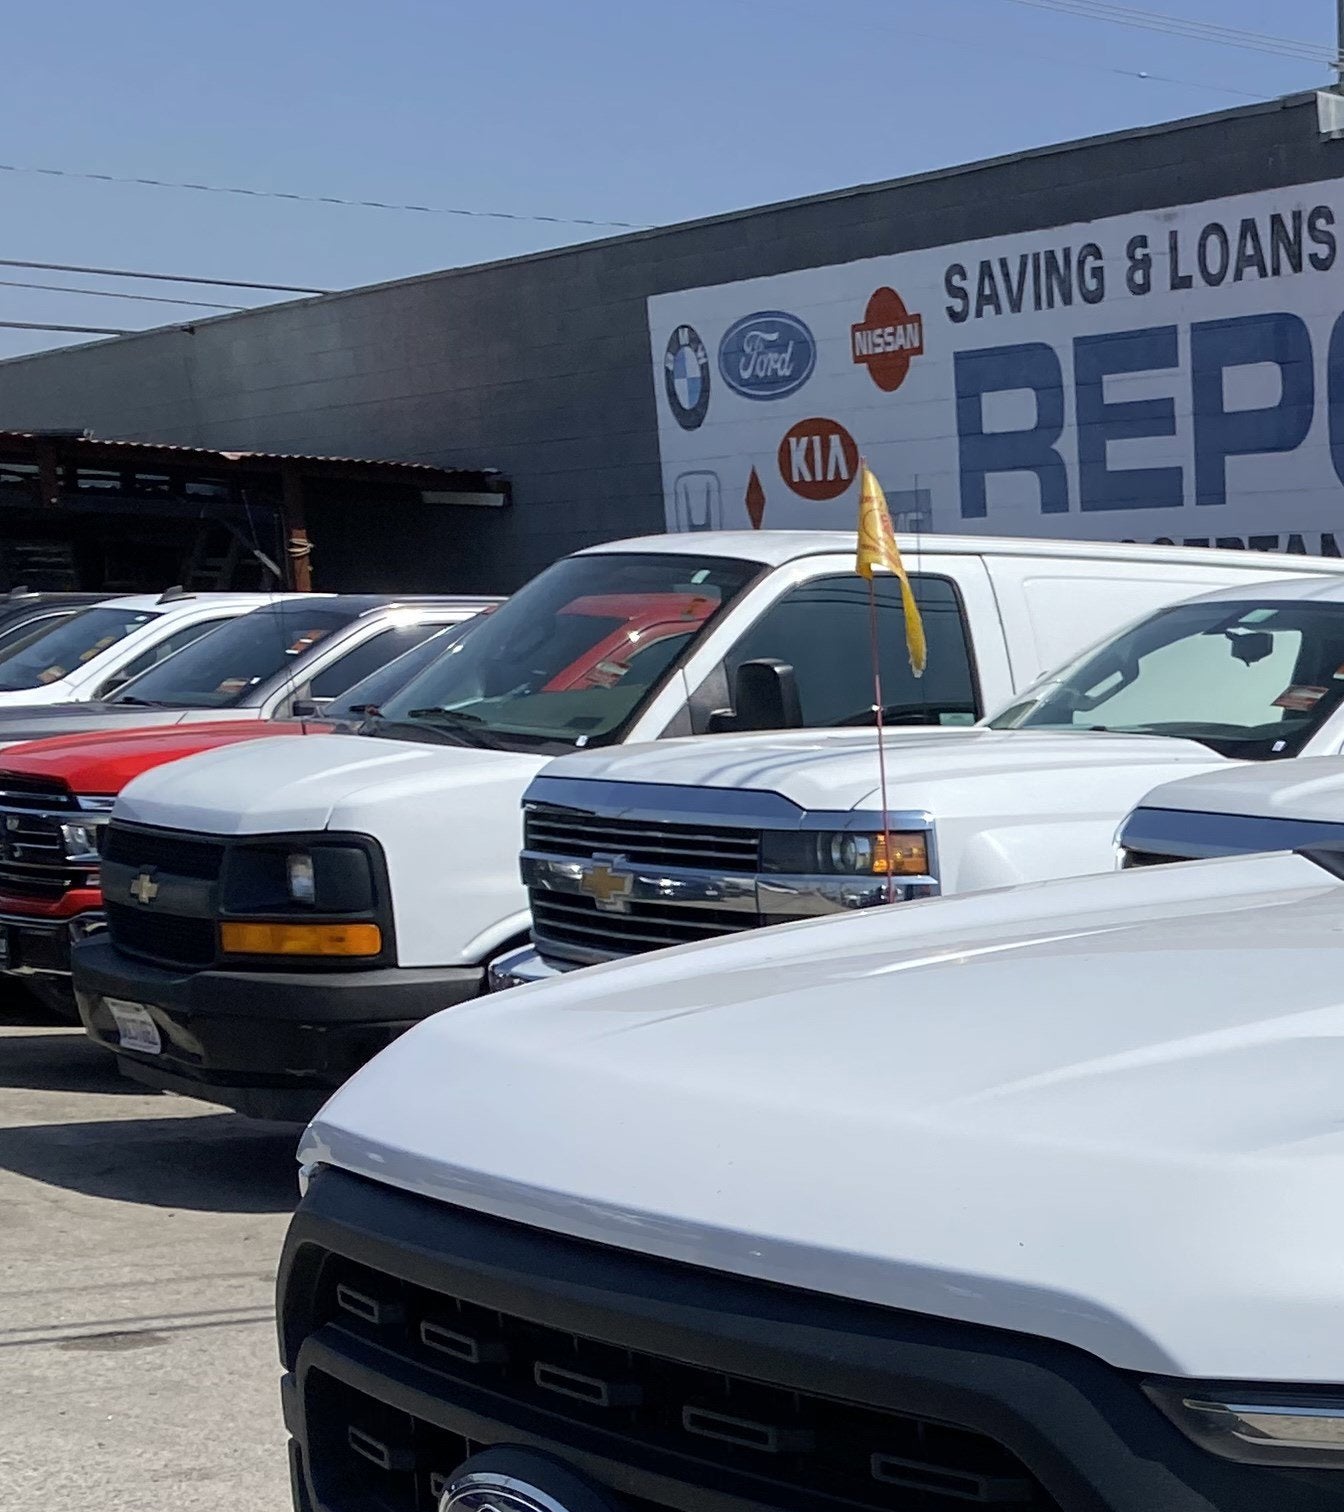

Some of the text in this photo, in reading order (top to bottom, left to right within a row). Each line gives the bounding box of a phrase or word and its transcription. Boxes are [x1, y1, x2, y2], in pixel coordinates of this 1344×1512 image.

[945, 245, 1104, 323] SAVING
[1126, 235, 1150, 296] &
[1169, 206, 1337, 291] LOANS
[738, 330, 796, 380] Ford
[854, 323, 920, 356] NISSAN
[788, 434, 849, 482] KIA
